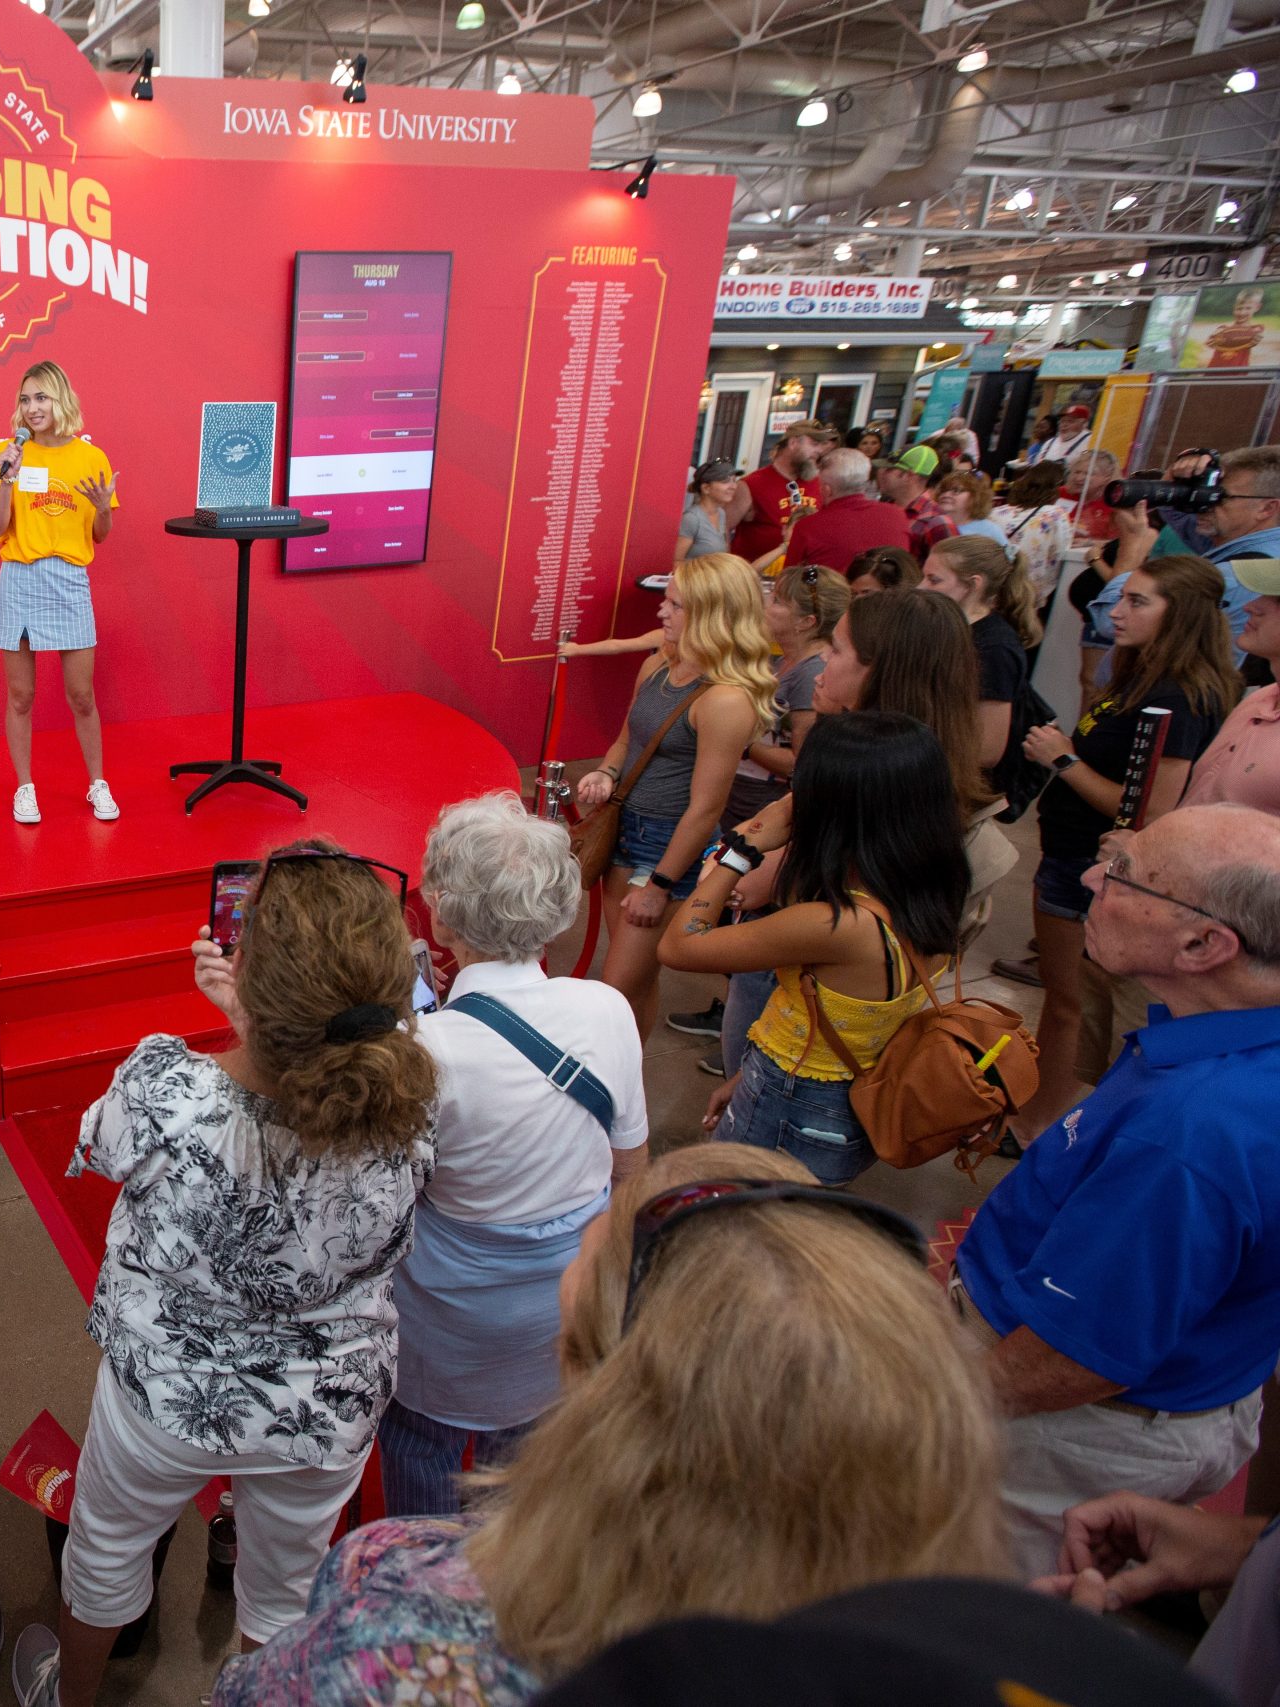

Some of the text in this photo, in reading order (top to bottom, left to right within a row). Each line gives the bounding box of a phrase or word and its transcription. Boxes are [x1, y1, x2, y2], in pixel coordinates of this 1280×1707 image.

[4, 91, 50, 145] STATE
[571, 246, 638, 266] FEATURING
[353, 264, 400, 279] THURSDAY
[1157, 255, 1211, 279] 400
[720, 279, 925, 299] Home Builders, Inc.
